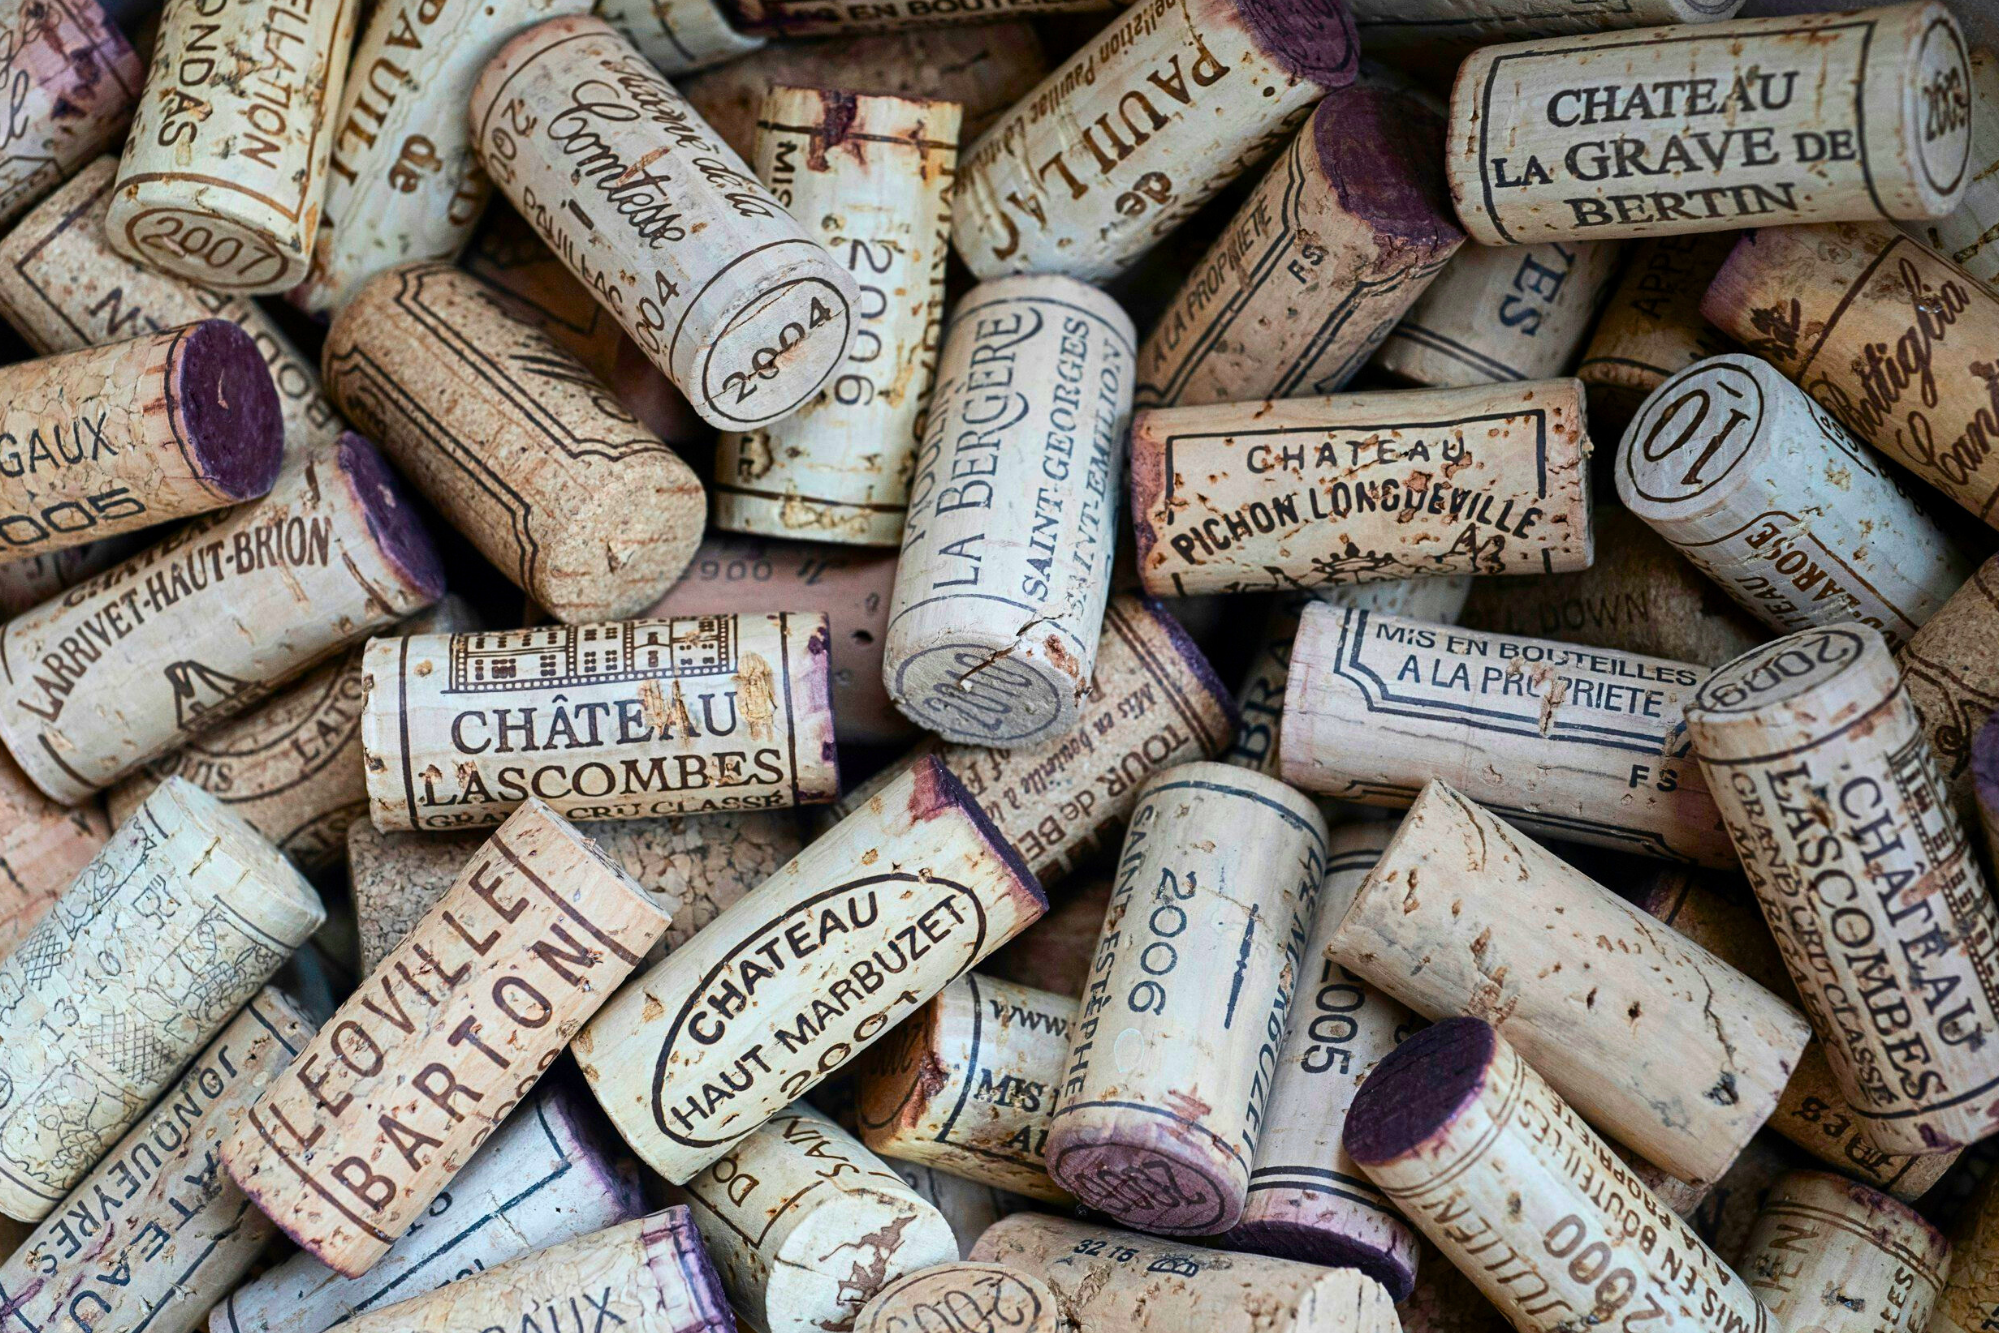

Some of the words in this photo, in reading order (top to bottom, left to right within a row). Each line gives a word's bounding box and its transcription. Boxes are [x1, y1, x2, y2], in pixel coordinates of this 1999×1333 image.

[1546, 70, 1800, 128] CHATEAU
[388, 134, 442, 194] de
[546, 80, 687, 250] Comtesse
[1491, 155, 1554, 189] LA
[1564, 128, 1780, 182] GRAVE
[1792, 130, 1858, 164] DE
[1114, 171, 1173, 218] de
[1562, 182, 1802, 230] BERTIN
[140, 216, 277, 278] 2007
[722, 296, 833, 405] 2004
[833, 238, 895, 407] 2006
[934, 306, 1044, 518] BERGÈRE
[1246, 437, 1467, 475] CHATEAU
[0, 486, 147, 552] 005
[1169, 494, 1299, 566] PICHON
[932, 532, 986, 591] LA
[16, 515, 333, 723] LARRIVET-HAUT-BRION
[1374, 622, 1437, 649] MIS
[1446, 635, 1489, 657] EN
[1498, 642, 1699, 687] BOUTEILLES
[1397, 654, 1421, 685] A
[1430, 658, 1472, 692] LA
[451, 691, 739, 754] CHÂTEAU
[1119, 681, 1158, 721] Mis
[419, 747, 785, 808] LASCOMBES
[1097, 722, 1191, 801] TOUR
[565, 803, 642, 821] CRU
[650, 790, 790, 818] CLASSÉ
[1061, 792, 1098, 827] de
[1730, 770, 1801, 899] GRAND
[1789, 903, 1838, 983] CRU
[1837, 775, 1980, 1047] CHÂTEAU
[1127, 865, 1199, 1016] 2006
[1765, 761, 1949, 1102] LASCOMBES
[687, 890, 880, 1047] CHATEAU
[268, 859, 532, 1152] LEOVILLE
[670, 1044, 774, 1132] HAUT
[773, 892, 969, 1055] MARBUZET
[330, 921, 602, 1214] BARTON
[40, 1043, 238, 1279] JONQUEYRES
[68, 1136, 224, 1333] ATEAU
[1072, 1238, 1101, 1258] 32
[1542, 1213, 1668, 1333] 2000
[1659, 1245, 1698, 1296] EN
